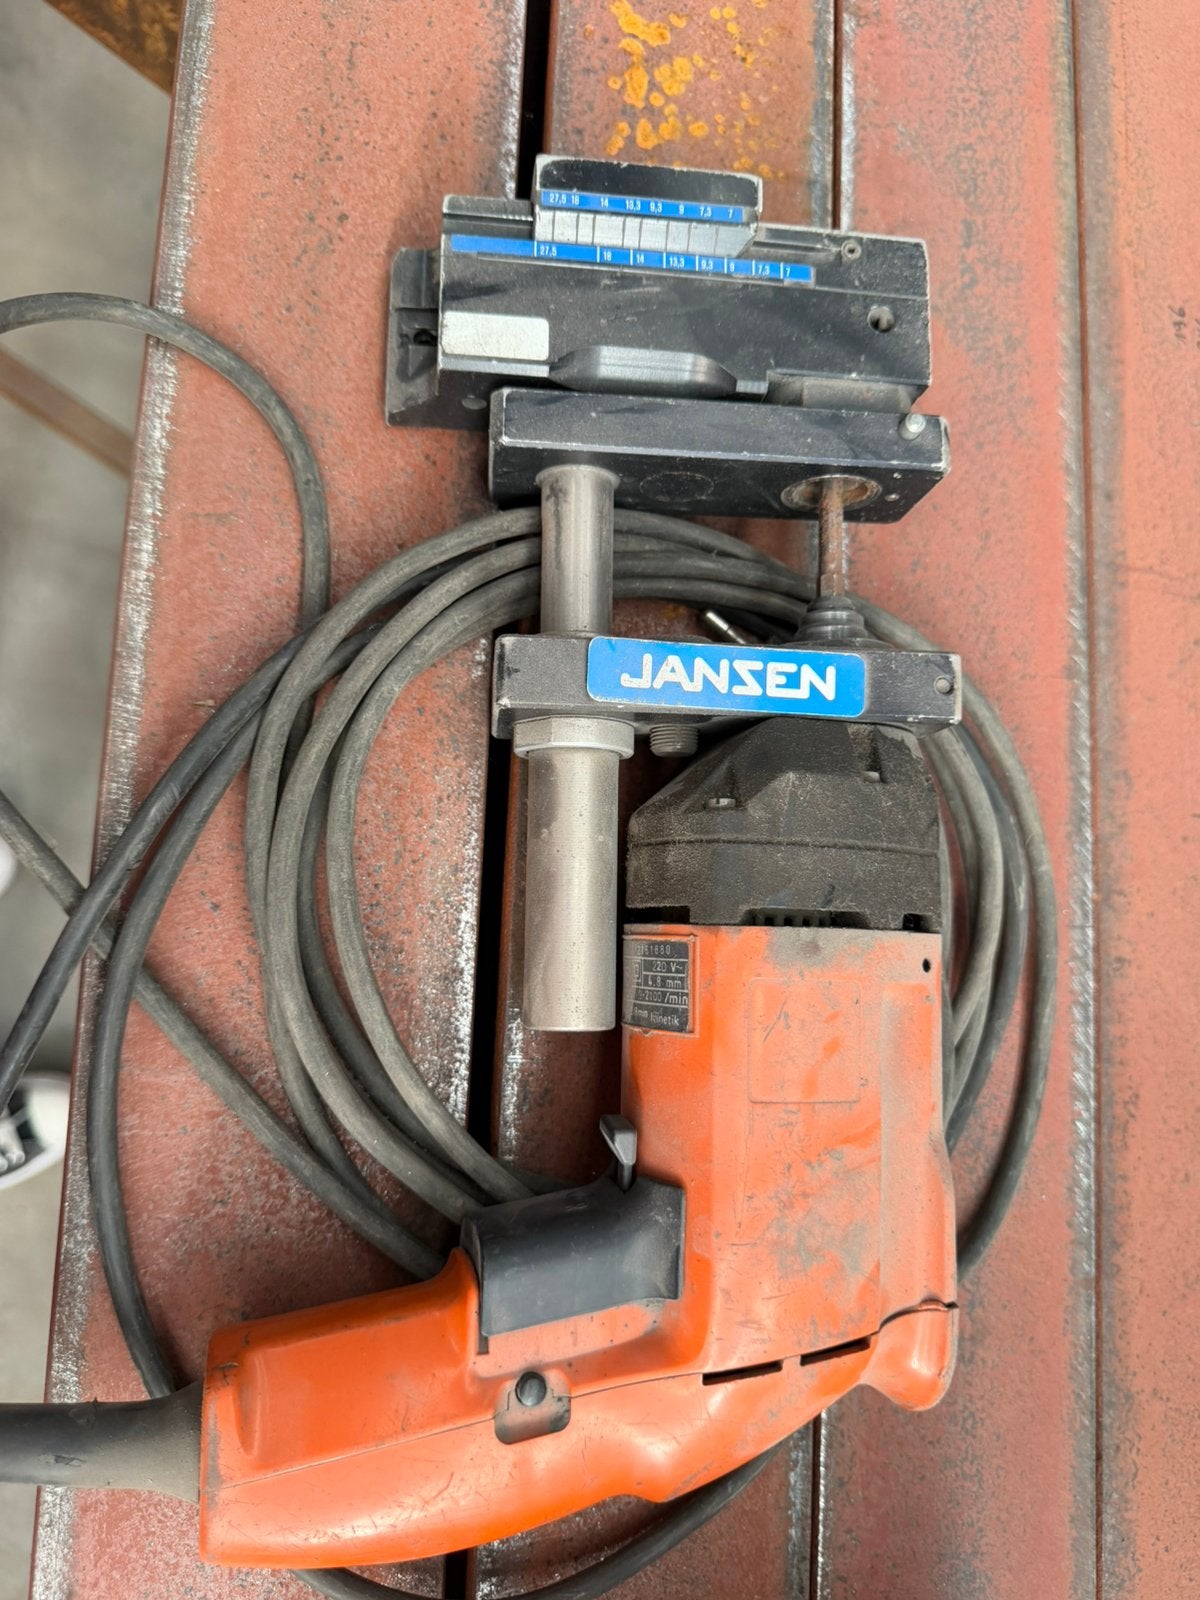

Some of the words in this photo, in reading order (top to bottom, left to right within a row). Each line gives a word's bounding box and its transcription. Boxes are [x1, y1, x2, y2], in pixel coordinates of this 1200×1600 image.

[549, 193, 567, 204] 27,5
[600, 197, 609, 208] 14
[625, 199, 641, 211] 13,3
[650, 201, 663, 213] 9,3
[679, 204, 685, 214] 9
[700, 206, 712, 217] 7,3
[728, 209, 734, 218] 7
[540, 245, 557, 257] 27,5
[636, 253, 645, 264] 14
[669, 256, 685, 268] 13,3
[701, 259, 714, 270] 9,3
[729, 262, 735, 272] 9
[758, 265, 770, 275] 7,3
[786, 267, 791, 277] 7
[620, 652, 836, 701] JANSEN
[652, 961, 667, 972] 220
[666, 978, 682, 989] mm
